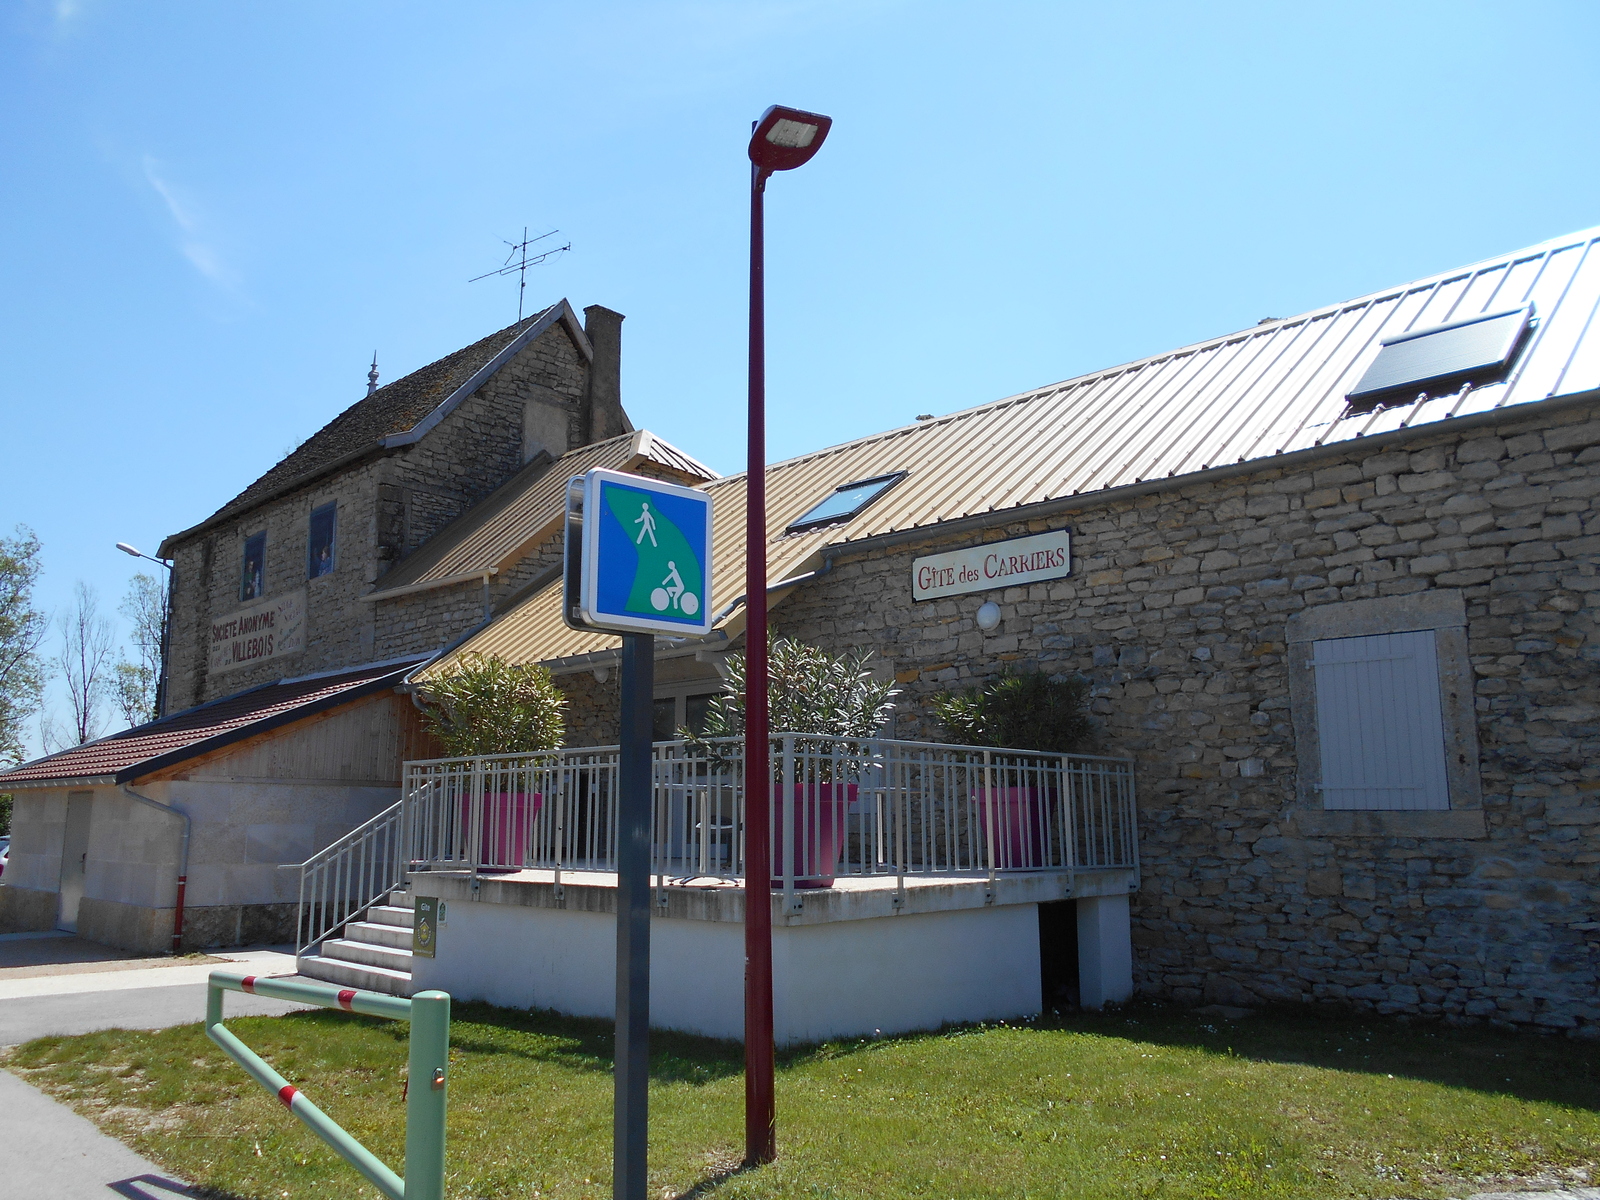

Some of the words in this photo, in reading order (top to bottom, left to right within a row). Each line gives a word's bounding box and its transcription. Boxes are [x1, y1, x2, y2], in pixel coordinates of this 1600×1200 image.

[959, 565, 979, 583] des
[984, 548, 1065, 579] CARRIERS
[238, 611, 275, 635] ANONYME
[232, 634, 273, 663] VILLEBOIS
